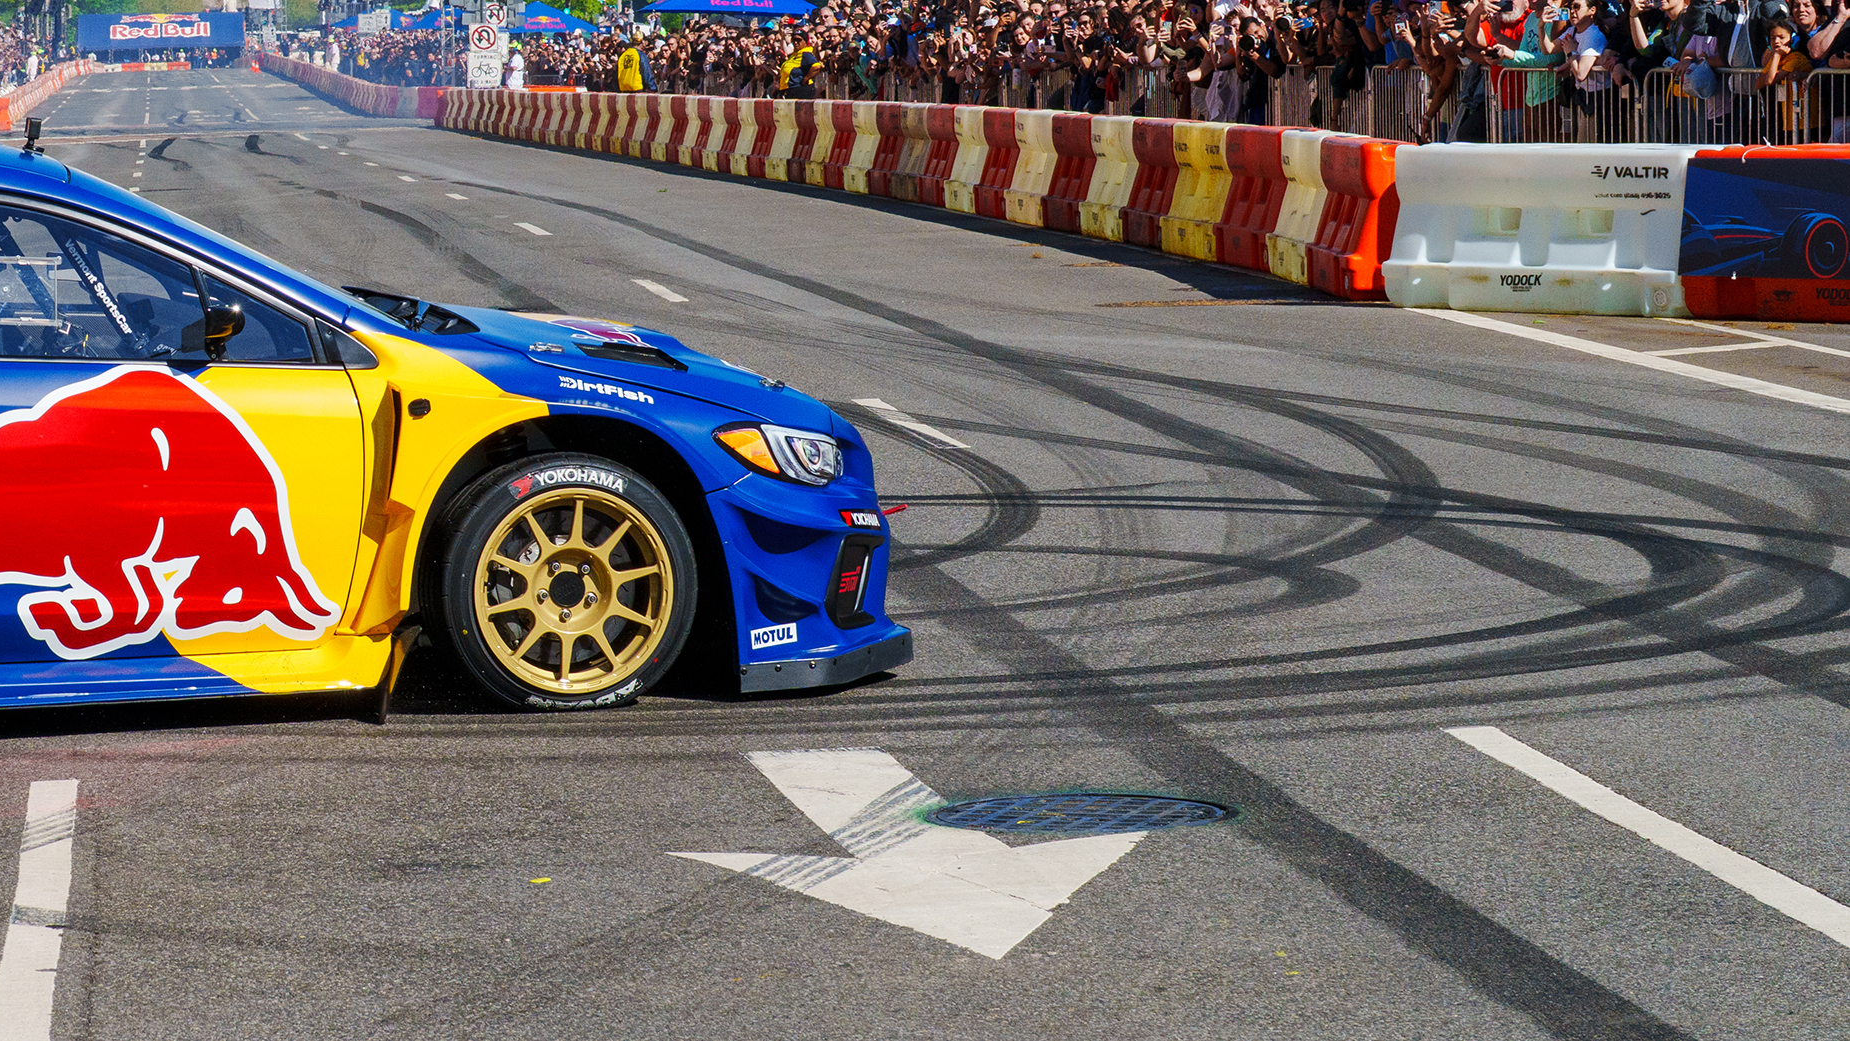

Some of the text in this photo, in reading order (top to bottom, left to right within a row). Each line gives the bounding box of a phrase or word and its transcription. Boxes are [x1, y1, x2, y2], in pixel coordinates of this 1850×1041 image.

[110, 22, 210, 40] Red Bull
[1614, 166, 1669, 179] VALTIR
[65, 238, 98, 284] Vermont
[1500, 274, 1541, 286] YODOCK
[535, 468, 624, 493] YOKOHAMA
[851, 513, 881, 527] YOKOHAMA
[754, 627, 793, 646] MOTUL
